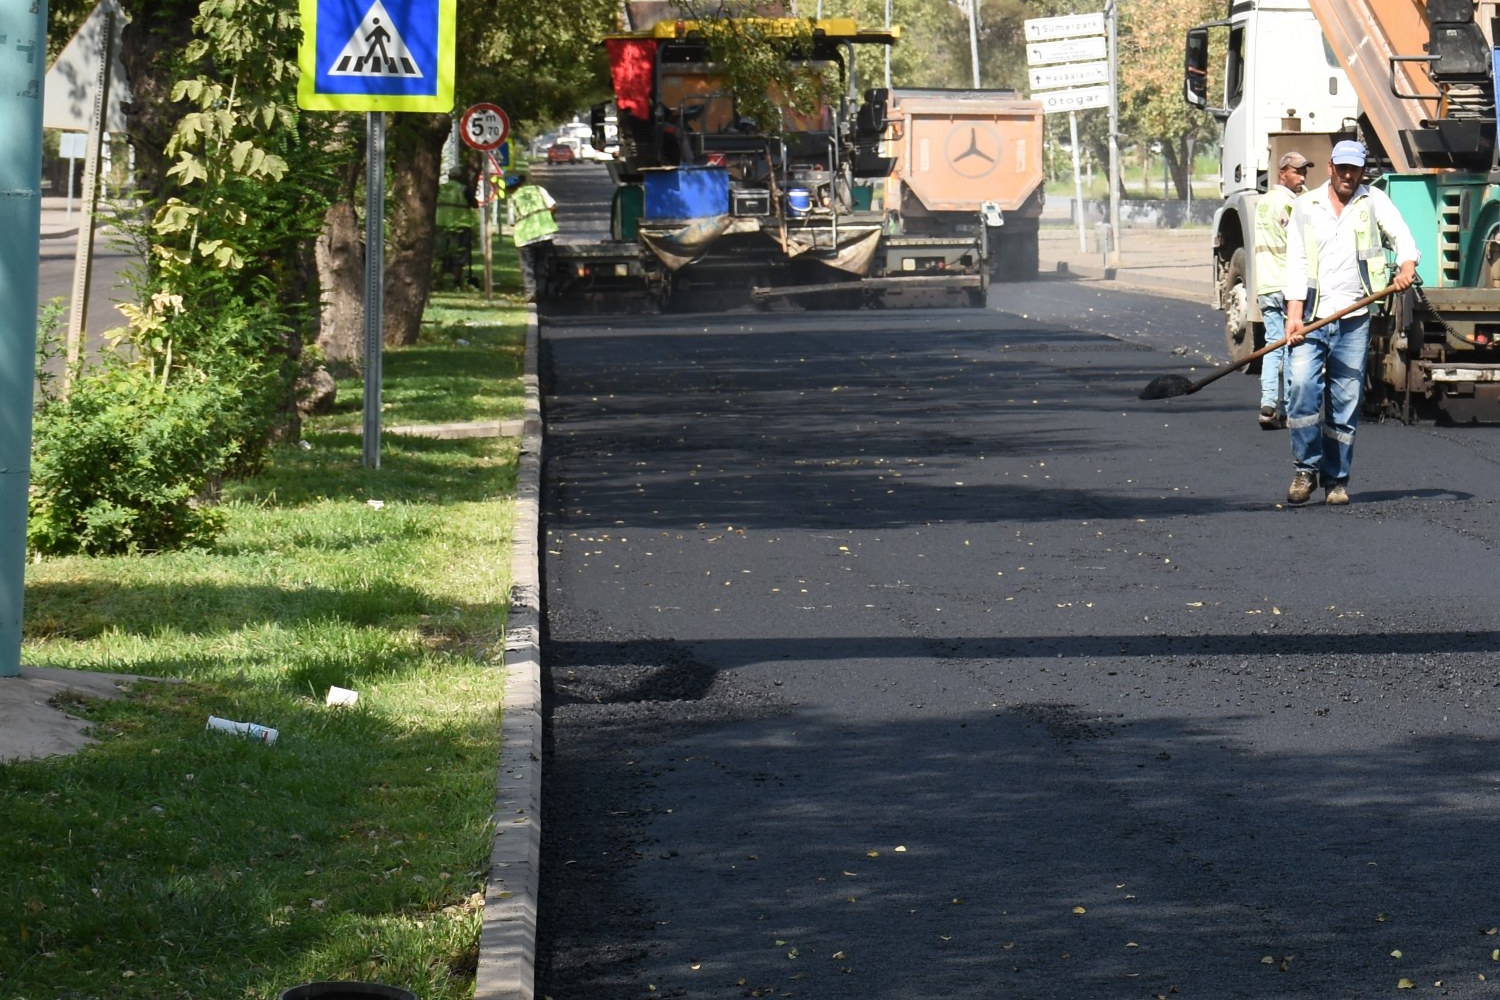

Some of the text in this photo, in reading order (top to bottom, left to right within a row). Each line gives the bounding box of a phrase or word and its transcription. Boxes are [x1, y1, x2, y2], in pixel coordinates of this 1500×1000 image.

[1048, 94, 1100, 107] Otogar
[472, 118, 484, 137] 5
[488, 126, 499, 136] 70
